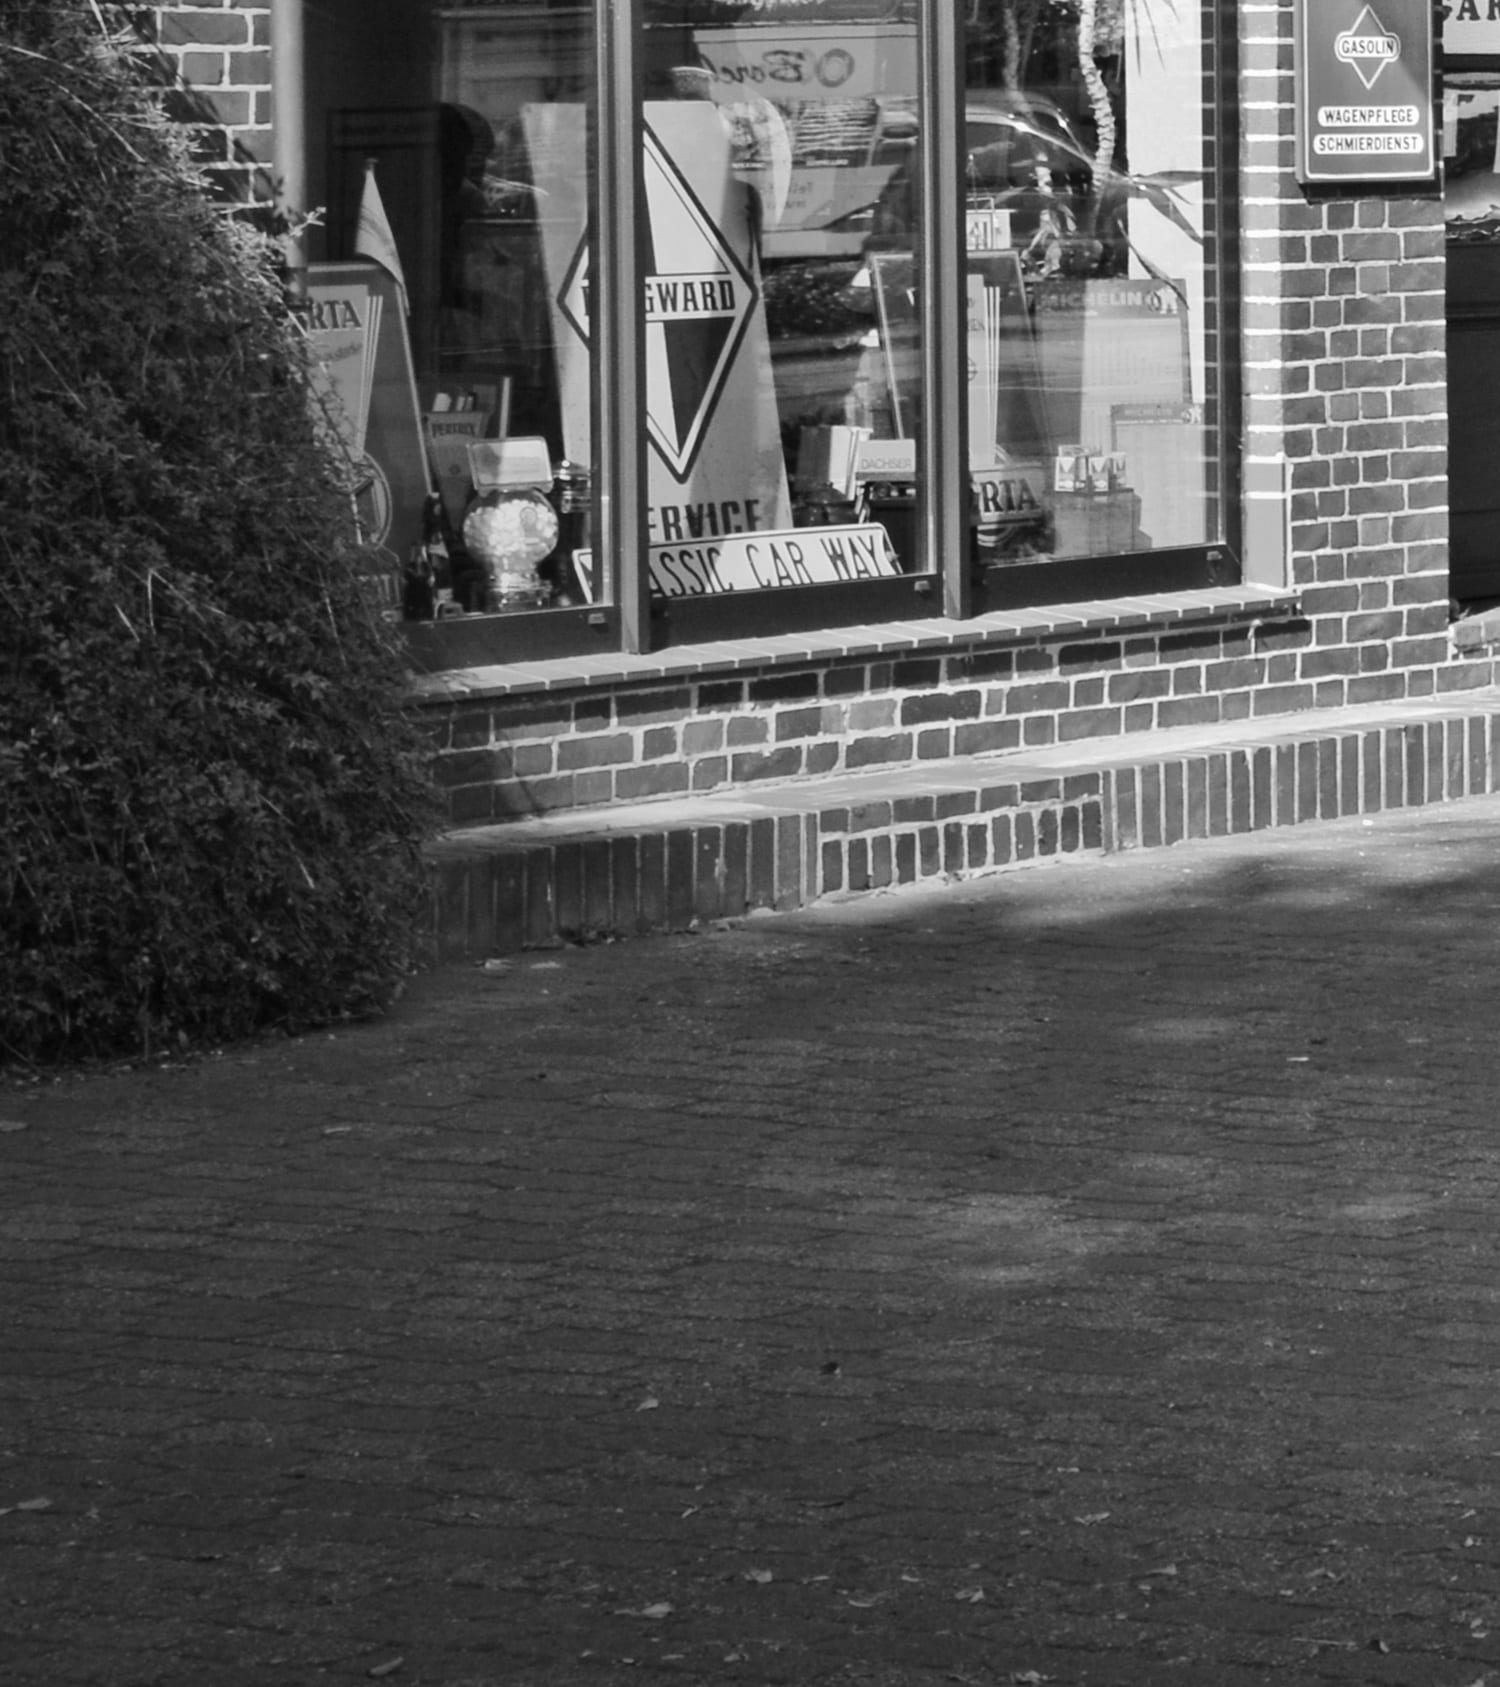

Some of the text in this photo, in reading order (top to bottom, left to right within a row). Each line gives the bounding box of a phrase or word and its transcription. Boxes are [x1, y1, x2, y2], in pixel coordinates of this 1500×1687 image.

[1341, 39, 1395, 55] GASOLIN
[1323, 108, 1413, 124] WAGENPFLEGE
[1317, 136, 1419, 152] SCHMIERDIENST
[1039, 290, 1143, 309] MICHELIN
[860, 457, 913, 471] DACHSER
[745, 539, 816, 591] CAR
[819, 534, 887, 582] WAY
